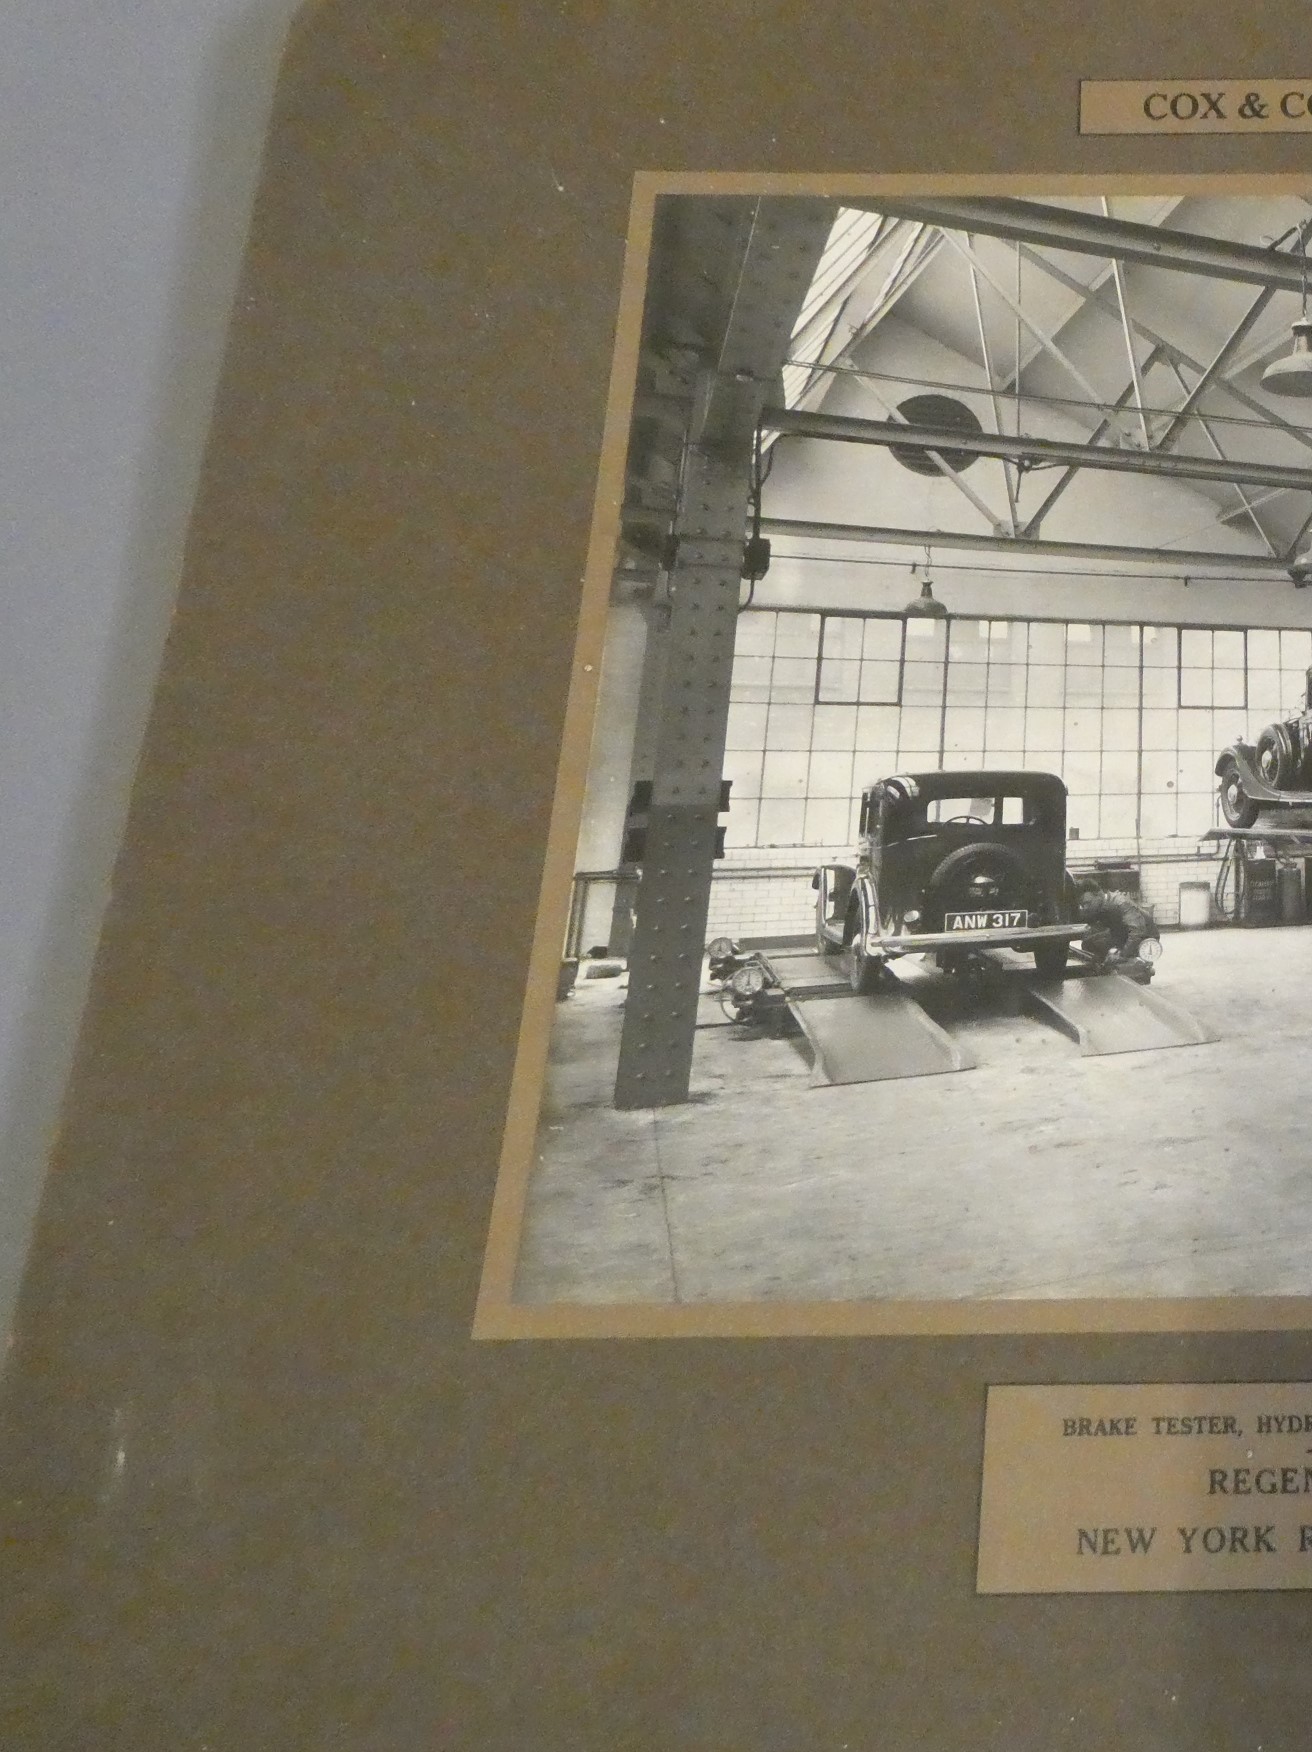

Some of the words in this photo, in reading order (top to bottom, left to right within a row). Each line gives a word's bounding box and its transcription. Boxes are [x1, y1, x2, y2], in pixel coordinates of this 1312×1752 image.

[1143, 92, 1227, 121] COX
[1237, 92, 1269, 120] &
[952, 914, 988, 930] ANW
[992, 912, 1022, 928] 317
[1062, 1415, 1138, 1437] BRAKE
[1150, 1414, 1243, 1438] TESTER,
[1076, 1526, 1157, 1556] NEW
[1176, 1525, 1277, 1554] YORK
